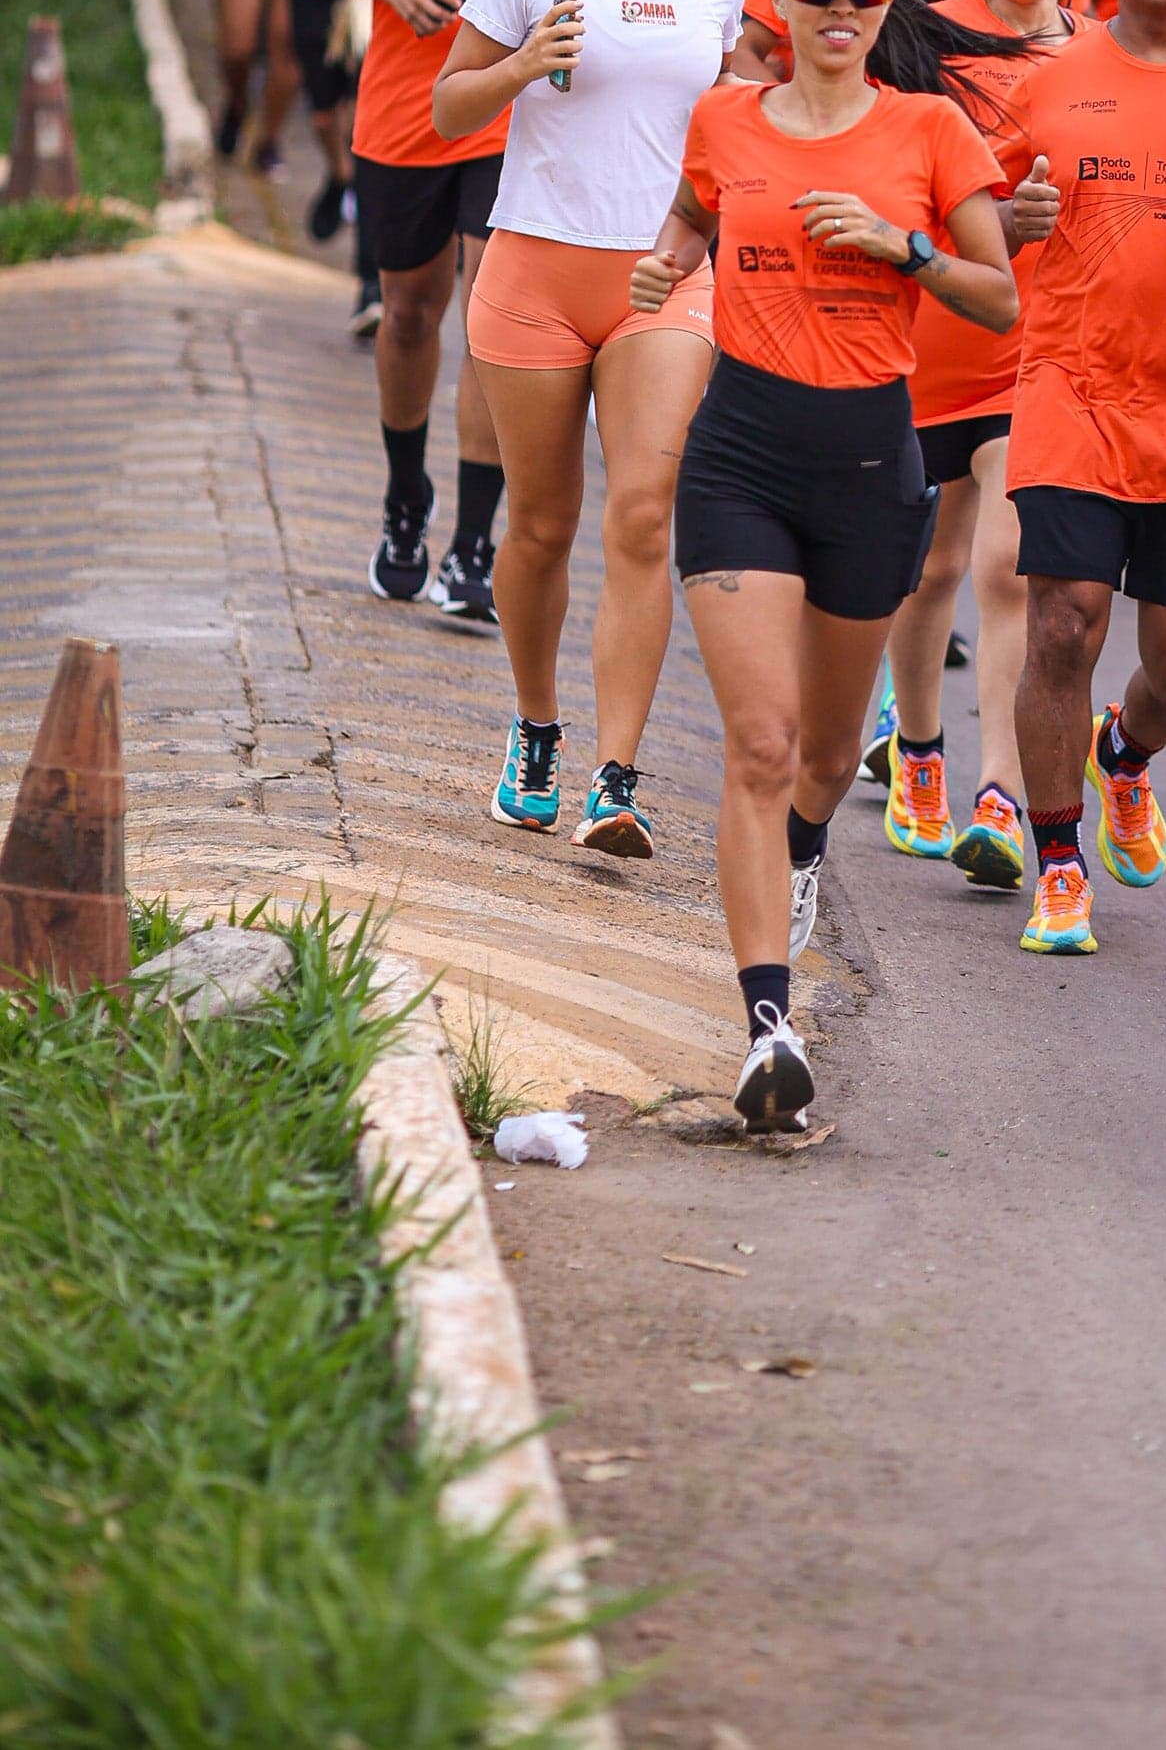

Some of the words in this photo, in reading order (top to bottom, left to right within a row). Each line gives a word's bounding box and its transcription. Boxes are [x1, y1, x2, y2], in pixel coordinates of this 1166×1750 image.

[1101, 157, 1131, 168] Porto
[1101, 170, 1136, 181] Saúde
[759, 247, 789, 258] Porto
[760, 260, 796, 272] Saúde
